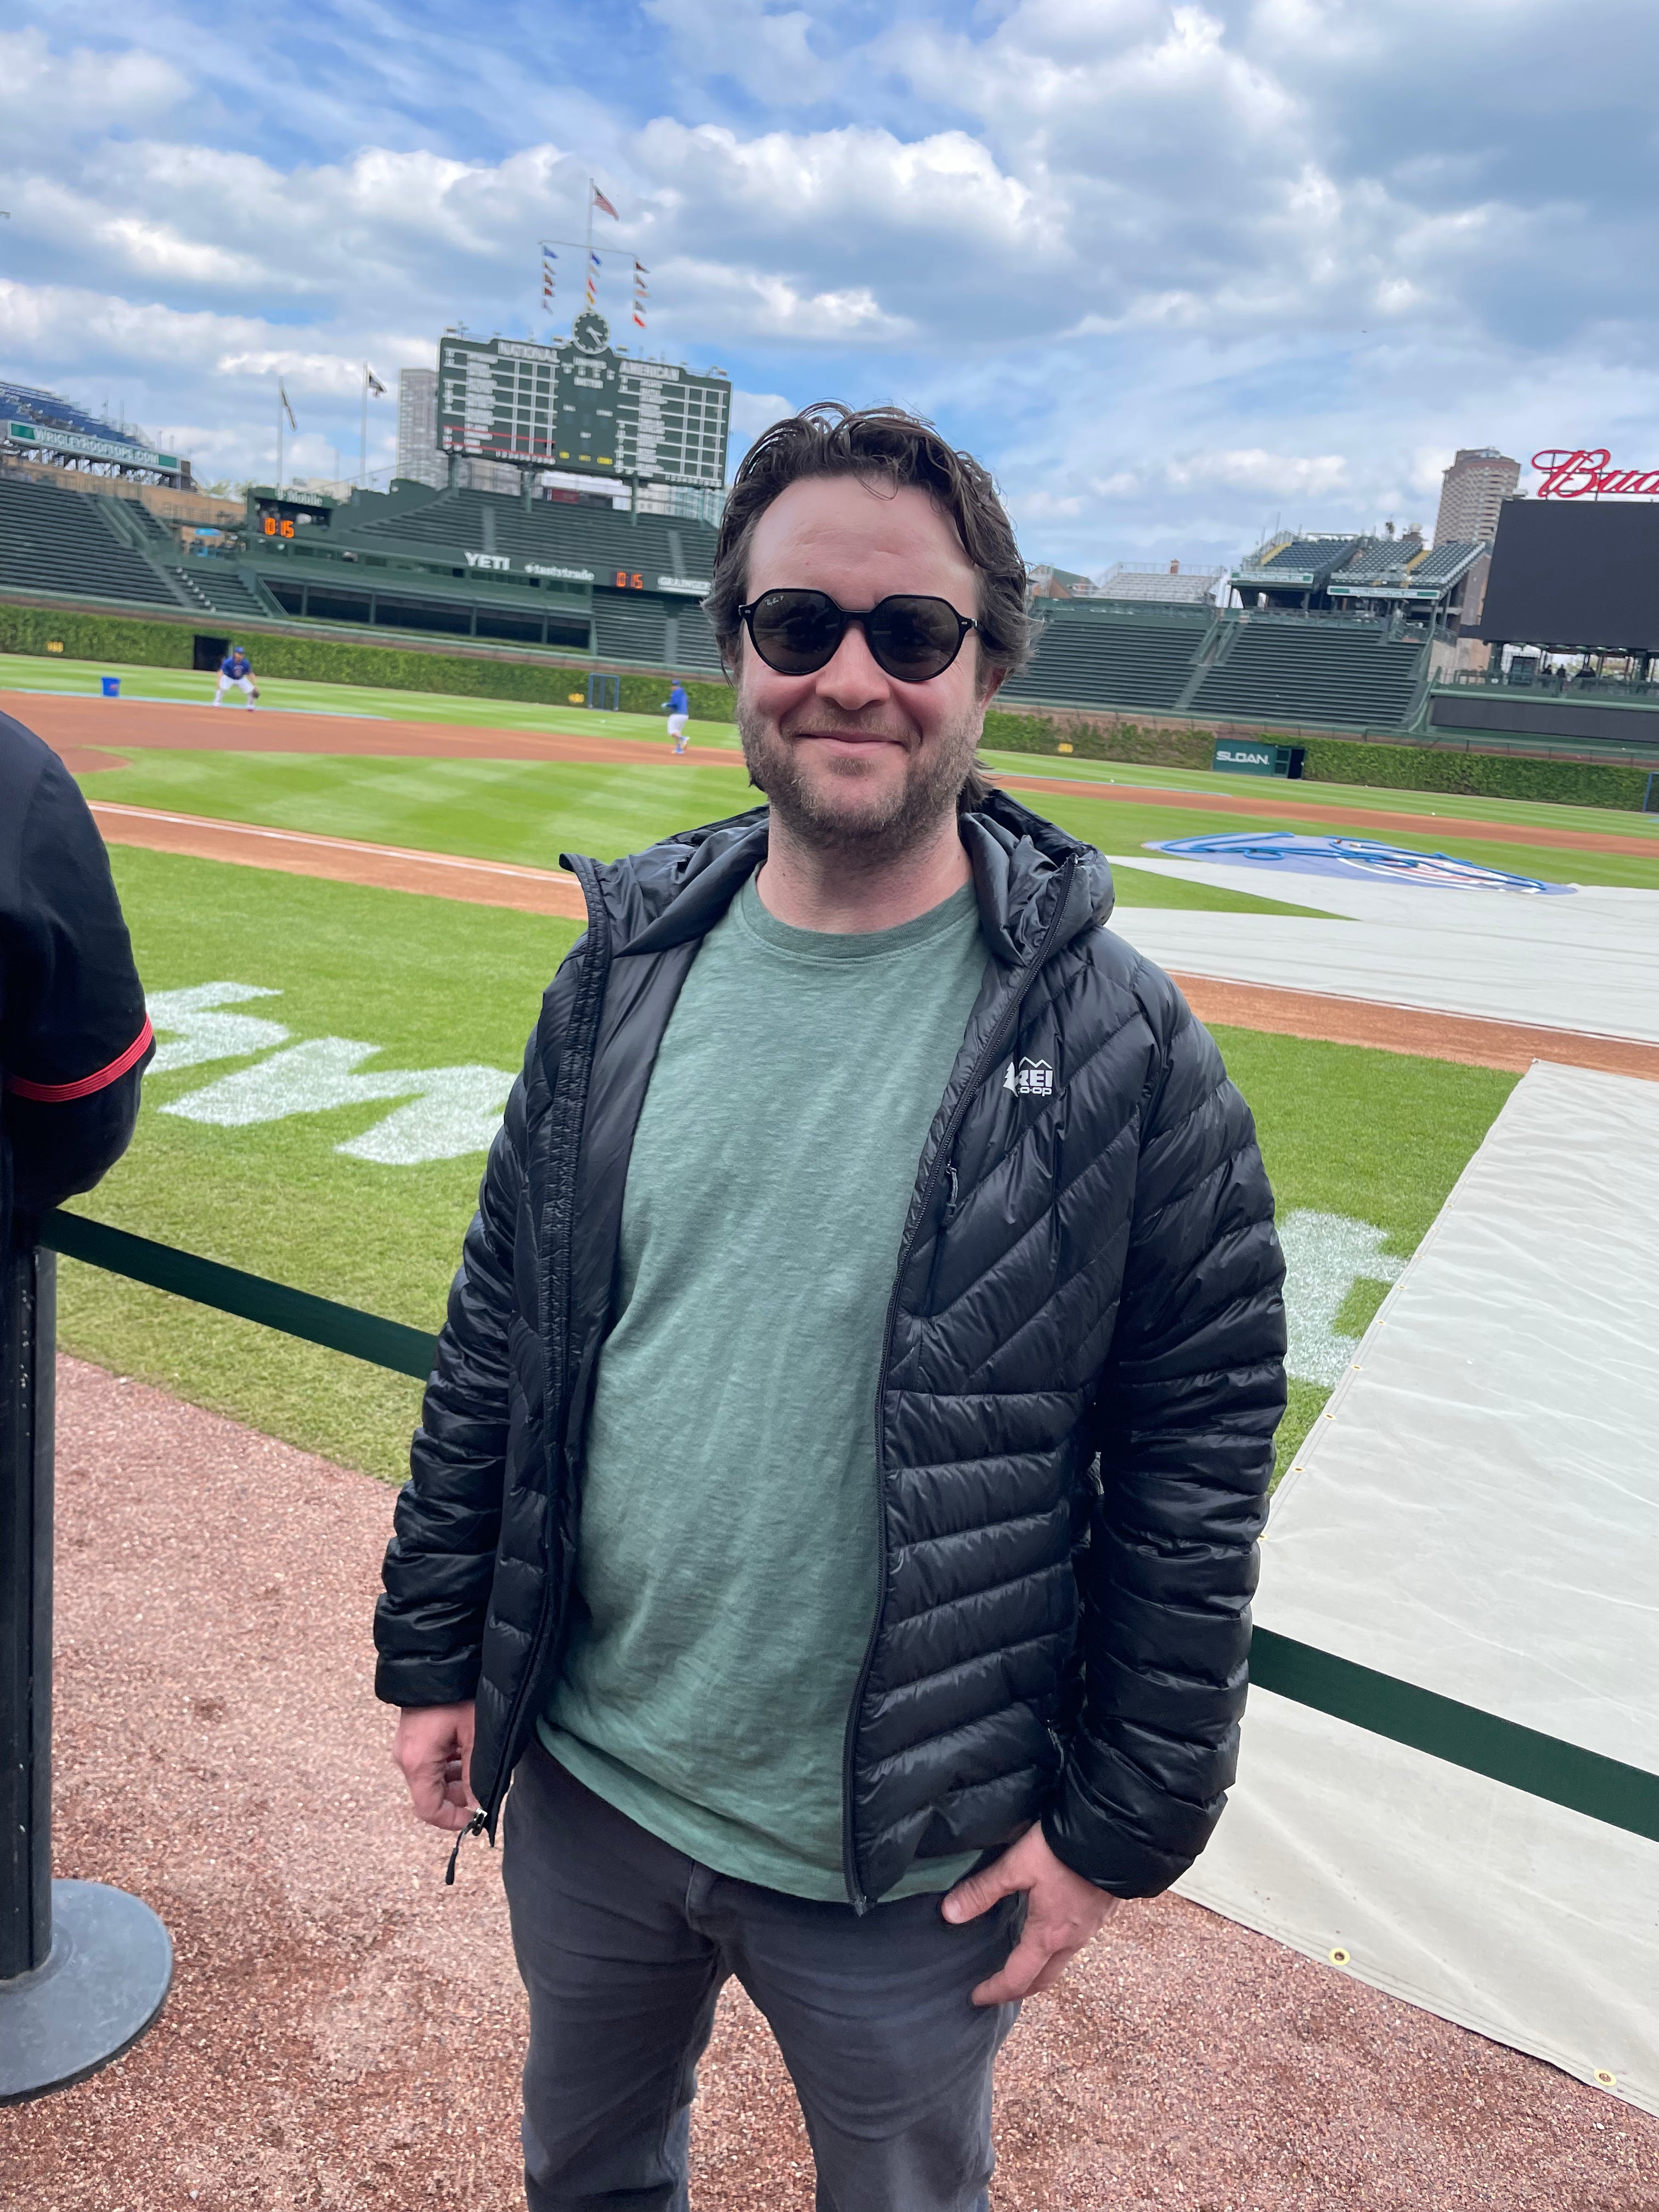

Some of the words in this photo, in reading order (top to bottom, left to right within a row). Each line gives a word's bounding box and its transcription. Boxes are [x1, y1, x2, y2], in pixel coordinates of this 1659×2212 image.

[498, 340, 560, 363] NATIONAL
[618, 360, 680, 381] AMERICAN
[464, 551, 511, 571] YETI
[1015, 1069, 1053, 1087] REI
